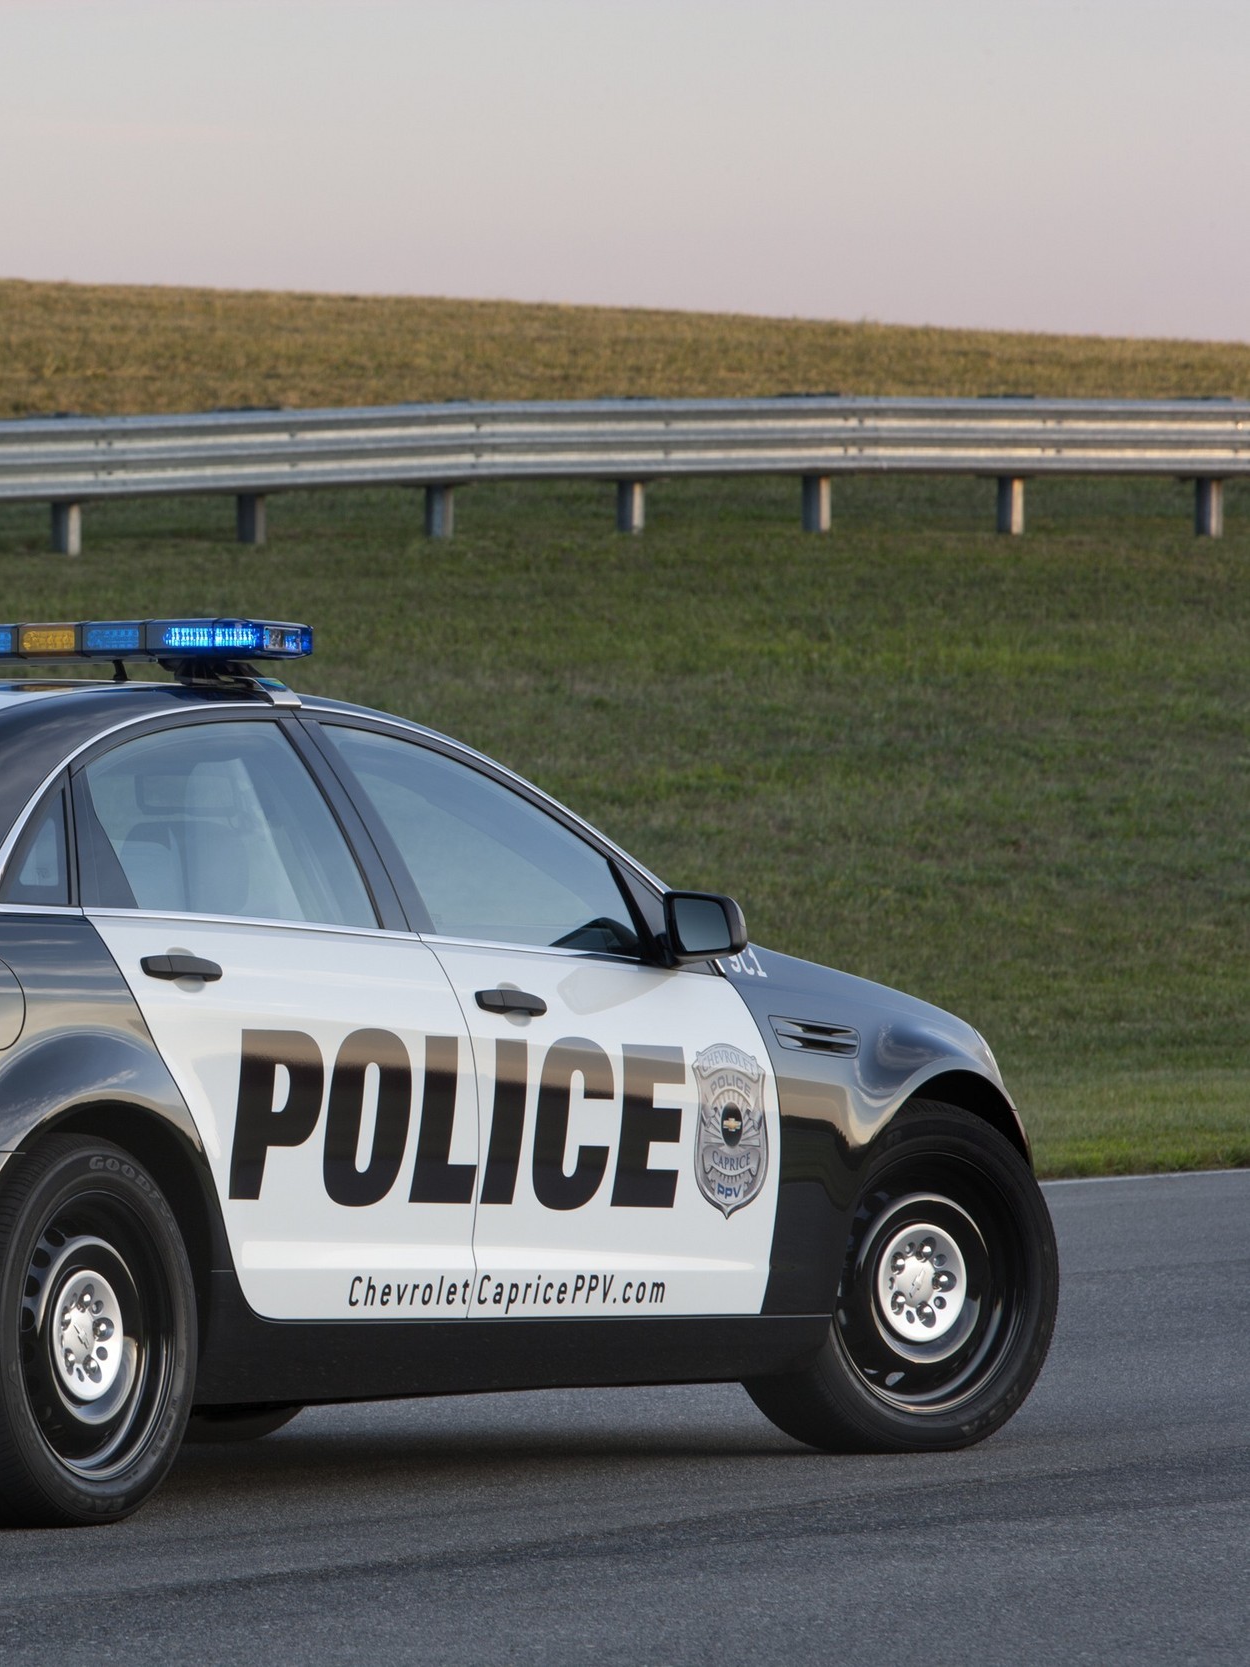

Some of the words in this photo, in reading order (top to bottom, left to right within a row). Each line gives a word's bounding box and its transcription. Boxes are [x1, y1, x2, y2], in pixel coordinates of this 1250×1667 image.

[701, 1050, 757, 1076] CHEVROLET
[710, 1074, 753, 1098] POLICE
[228, 1027, 686, 1211] POLICE
[711, 1149, 752, 1172] CAPRICE
[716, 1181, 743, 1200] PPV
